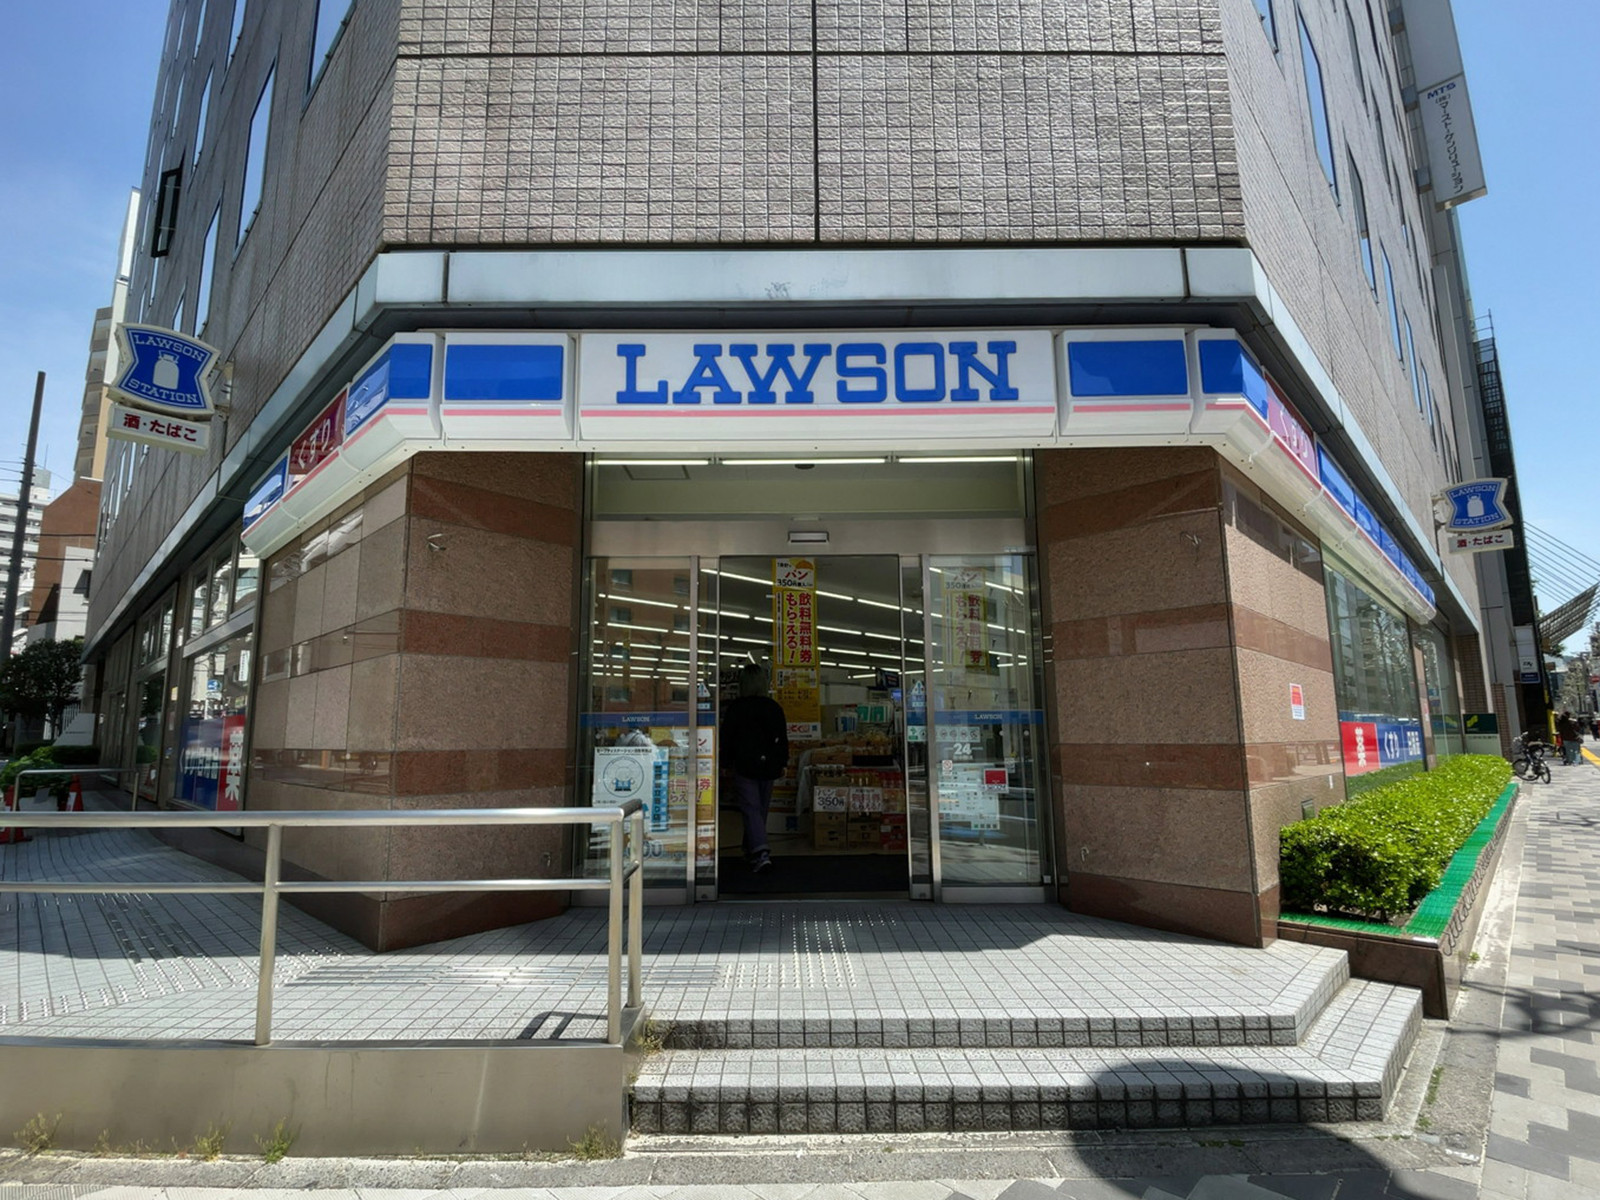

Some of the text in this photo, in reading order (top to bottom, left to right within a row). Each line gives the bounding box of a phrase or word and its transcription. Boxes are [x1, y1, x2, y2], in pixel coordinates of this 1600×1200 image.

[1427, 82, 1457, 100] MTS
[133, 334, 205, 362] LAWSON
[616, 340, 1020, 405] LAWSON
[127, 378, 200, 404] STATION
[123, 412, 198, 442] 酒・たばこ
[1450, 484, 1497, 498] LAWSON
[1454, 512, 1500, 525] STATION
[1457, 534, 1505, 548] 酒・たばこ
[785, 569, 809, 580] パン
[799, 592, 813, 663] 飲料無料券
[622, 715, 651, 723] LAWSON
[952, 742, 973, 756] 24
